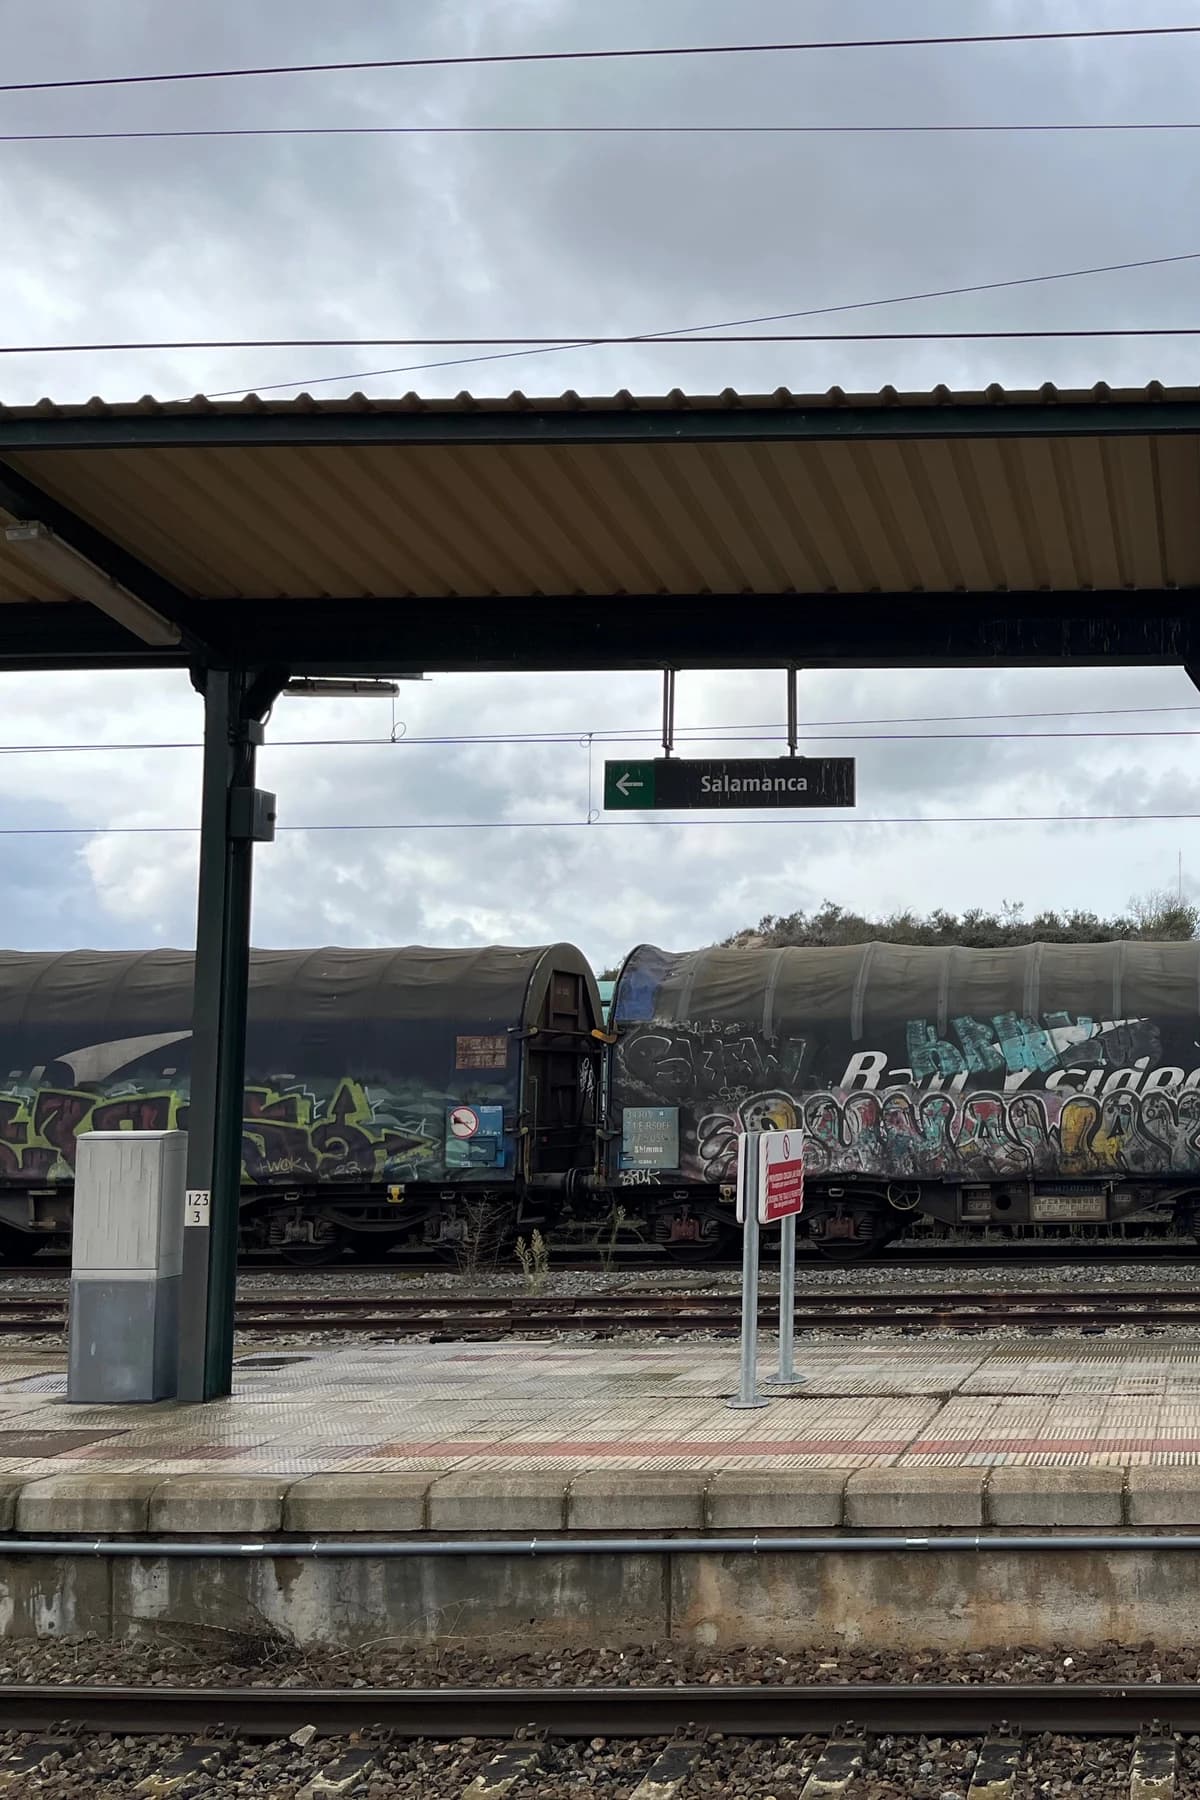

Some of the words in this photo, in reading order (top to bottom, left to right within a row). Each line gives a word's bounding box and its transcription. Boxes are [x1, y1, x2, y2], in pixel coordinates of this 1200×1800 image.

[701, 775, 808, 793] Salamanca
[188, 1193, 209, 1206] 123
[193, 1210, 201, 1223] 3
